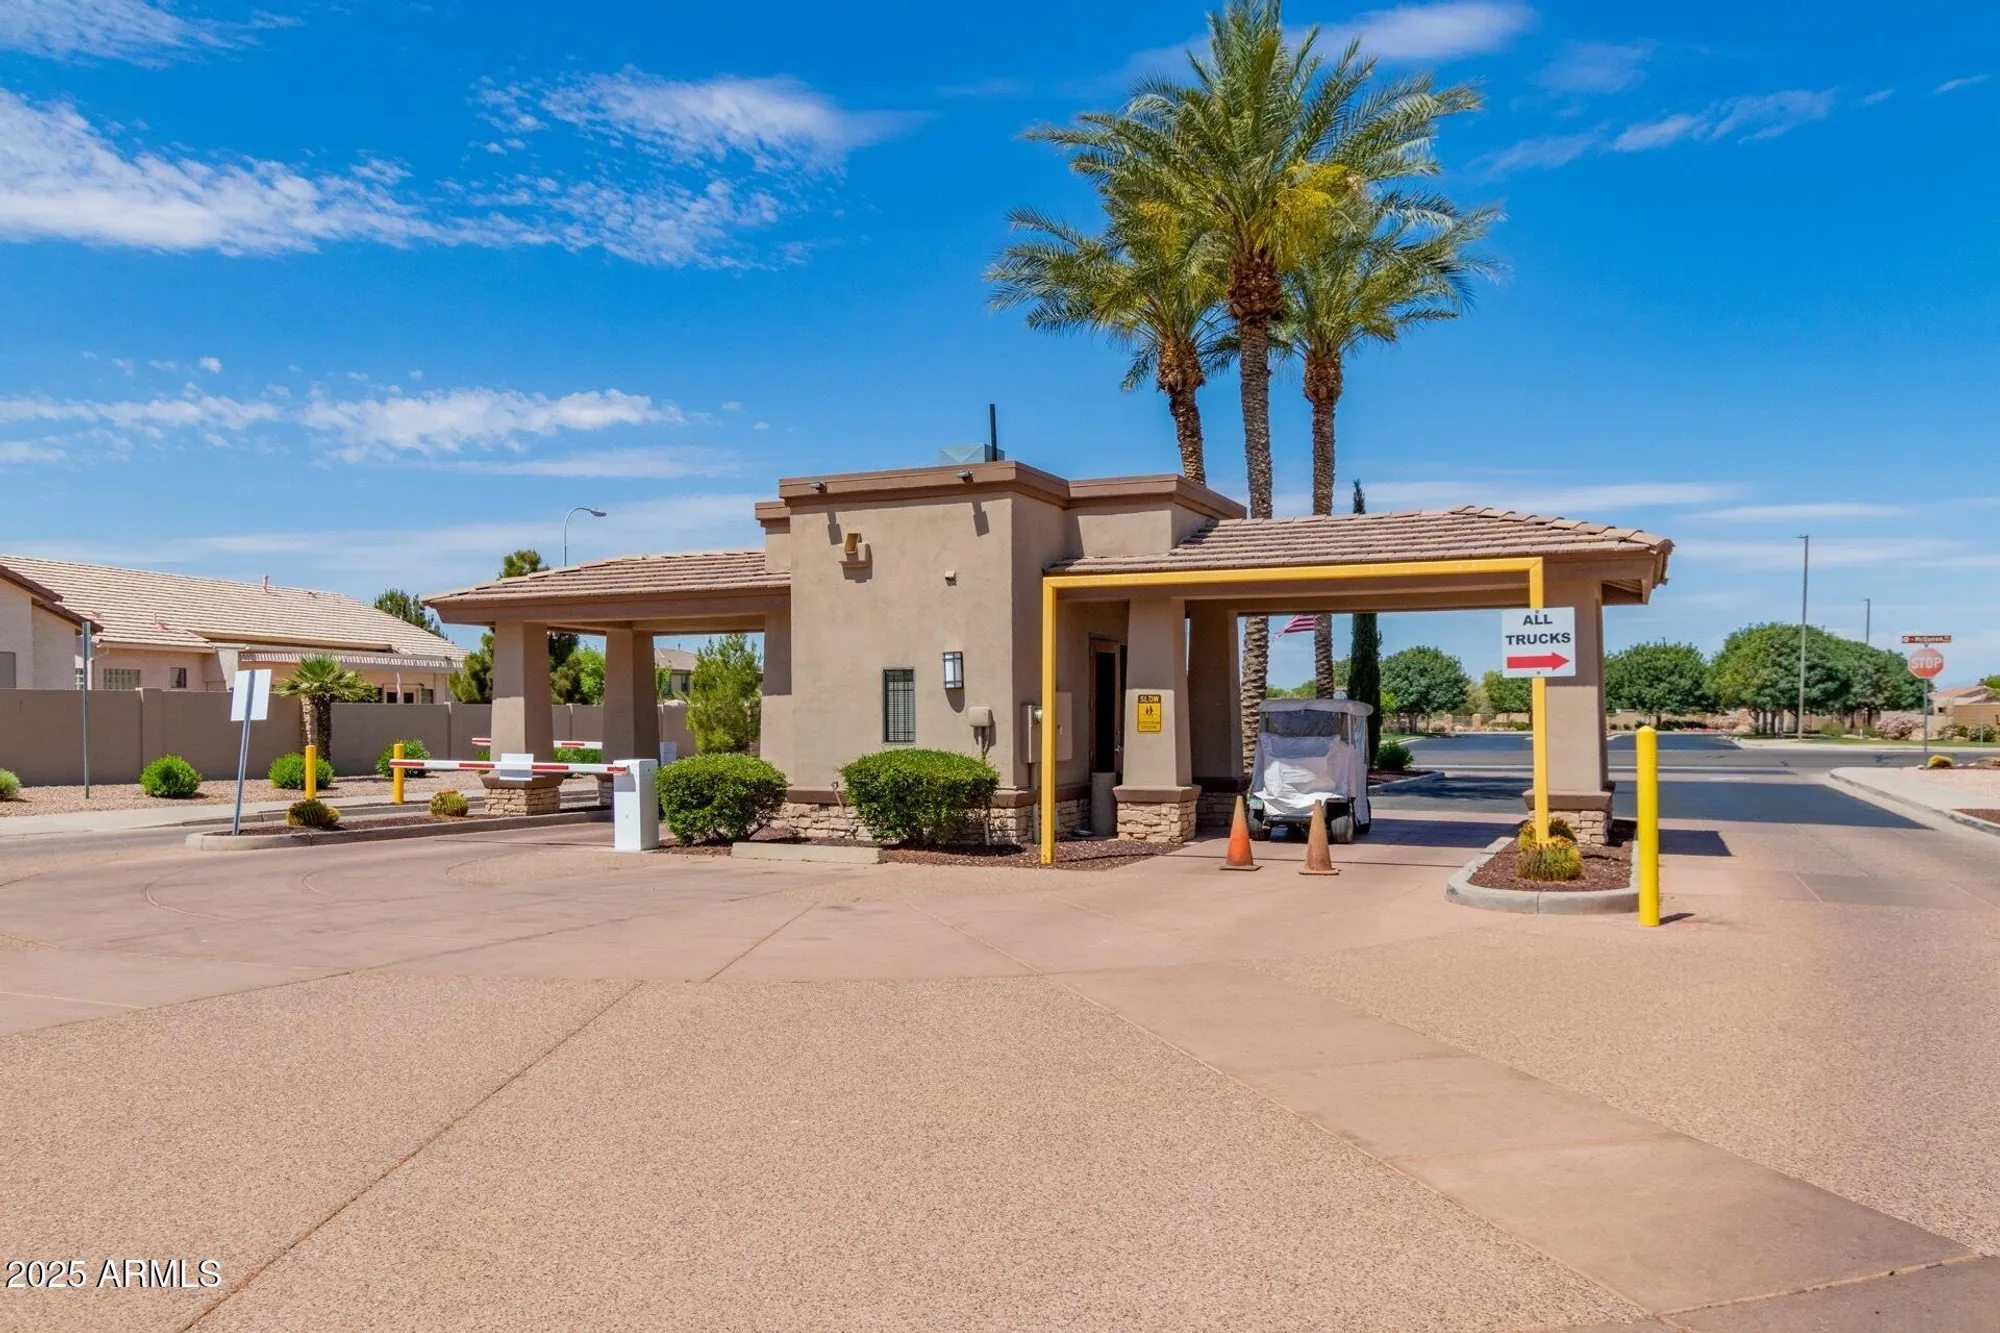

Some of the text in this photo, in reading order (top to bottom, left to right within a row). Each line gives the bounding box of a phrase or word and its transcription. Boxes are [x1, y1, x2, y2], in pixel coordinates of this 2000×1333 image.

[1523, 614, 1553, 626] ALL
[1505, 632, 1571, 645] TRUCKS
[1911, 658, 1942, 669] STOP
[1140, 695, 1160, 703] SLOW
